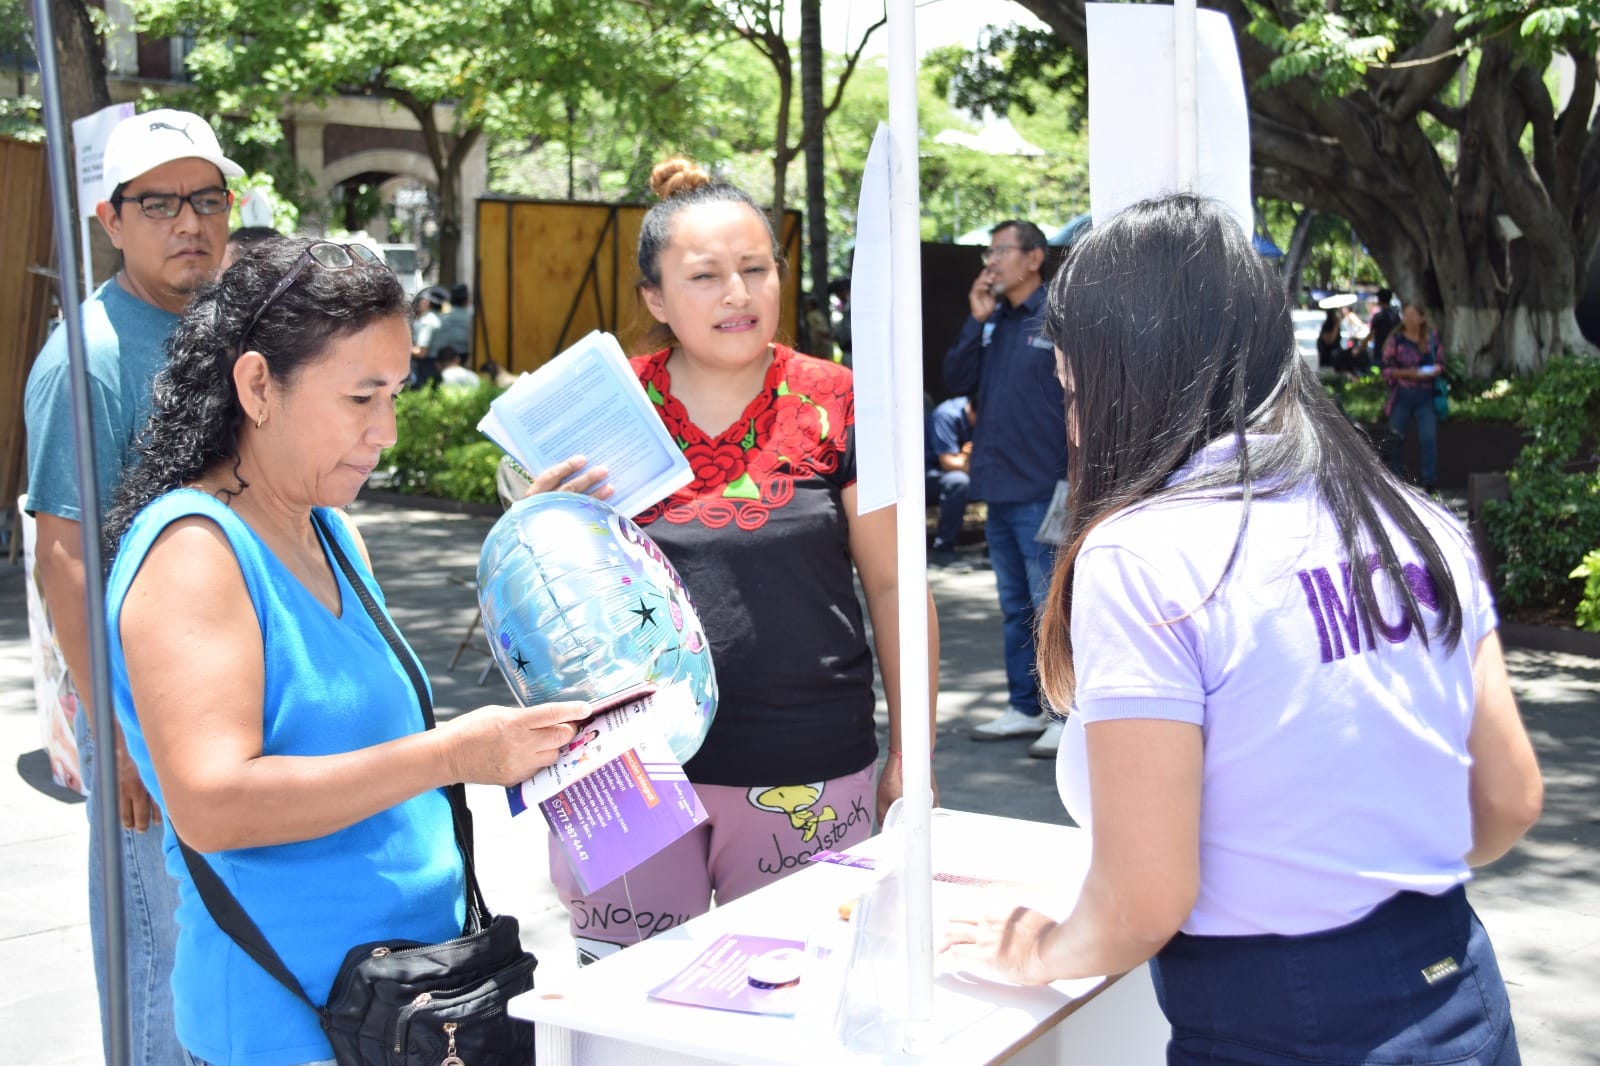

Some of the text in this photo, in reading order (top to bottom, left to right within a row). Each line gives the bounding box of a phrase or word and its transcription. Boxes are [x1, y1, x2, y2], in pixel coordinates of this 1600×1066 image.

[625, 752, 641, 776] ención
[580, 780, 593, 800] moción
[594, 773, 606, 790] yectos
[557, 809, 589, 862] 777 367 44 47
